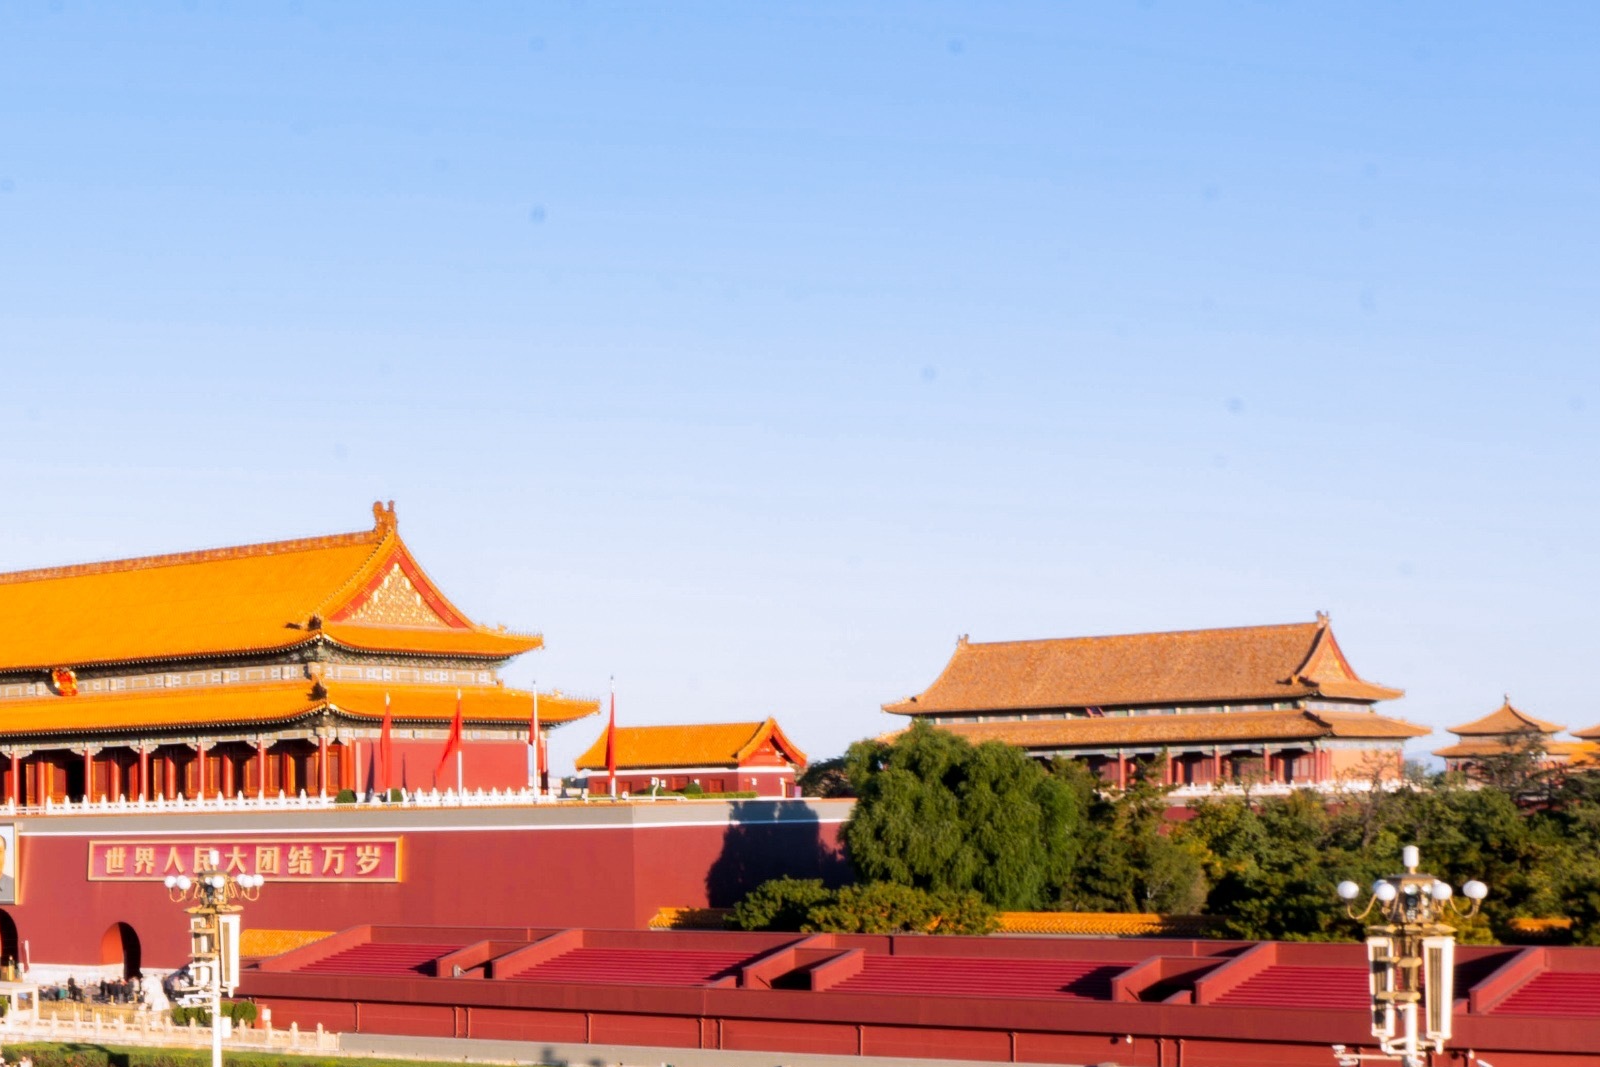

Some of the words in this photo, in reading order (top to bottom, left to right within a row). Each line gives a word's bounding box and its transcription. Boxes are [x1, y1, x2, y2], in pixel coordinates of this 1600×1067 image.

[104, 845, 382, 876] 世界人民大团结万岁
